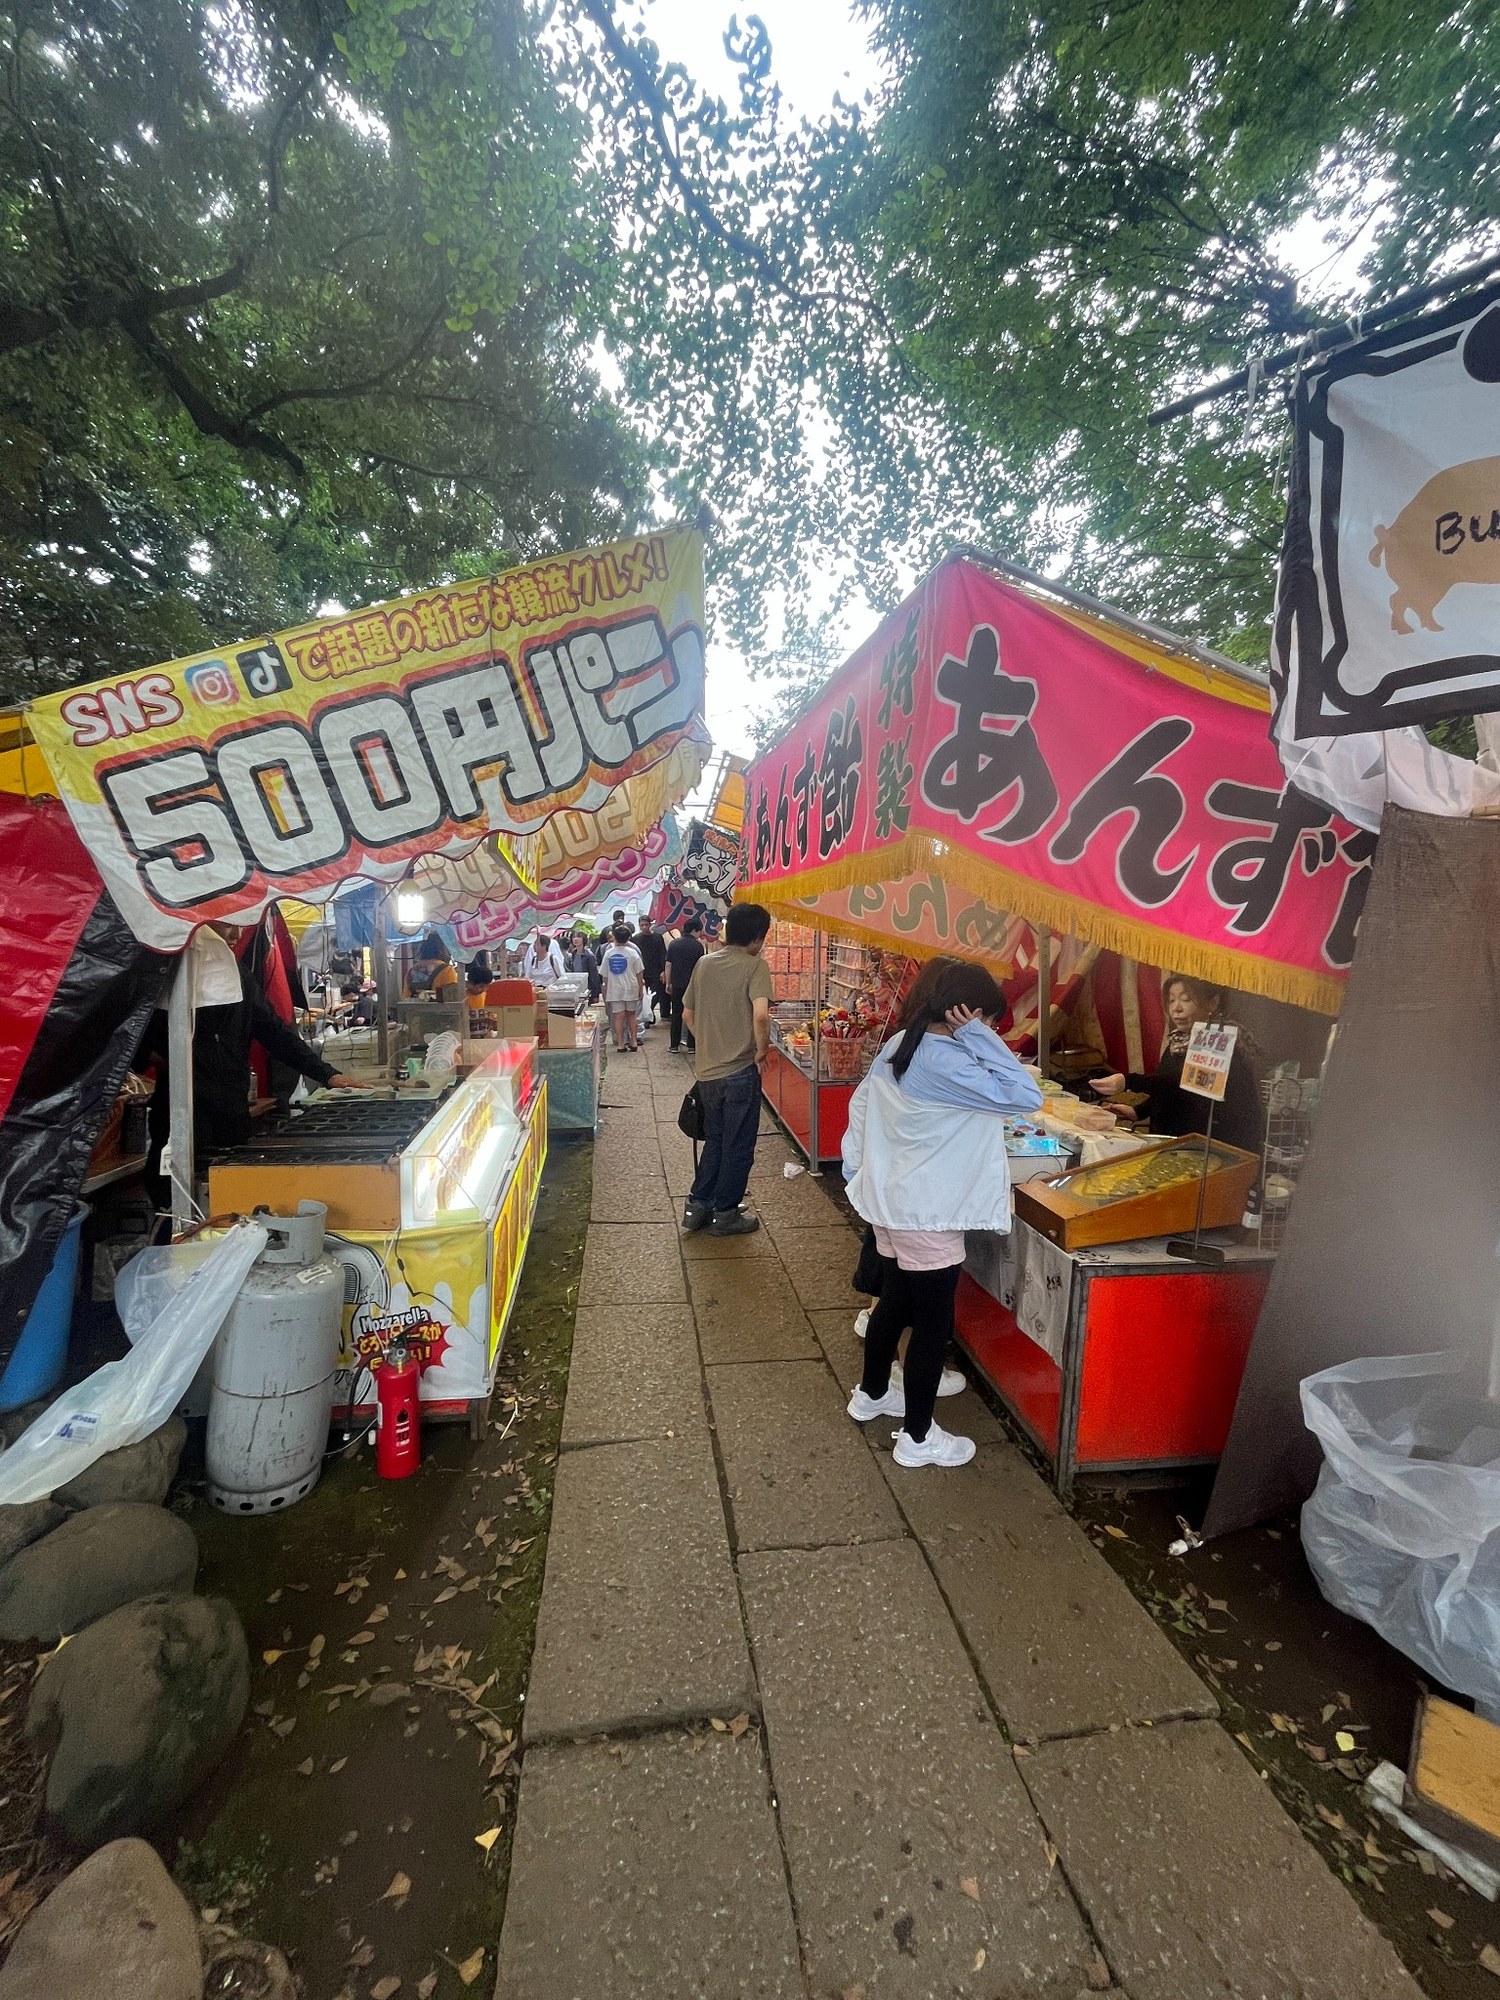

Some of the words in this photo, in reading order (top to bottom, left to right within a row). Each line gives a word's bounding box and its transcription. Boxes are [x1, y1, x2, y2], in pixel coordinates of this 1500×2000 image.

[60, 673, 184, 747] SNS
[286, 541, 668, 681] で話題の新たな韓流グルメ!
[101, 608, 701, 907] 500円パン
[359, 1306, 430, 1334] Mozzarella
